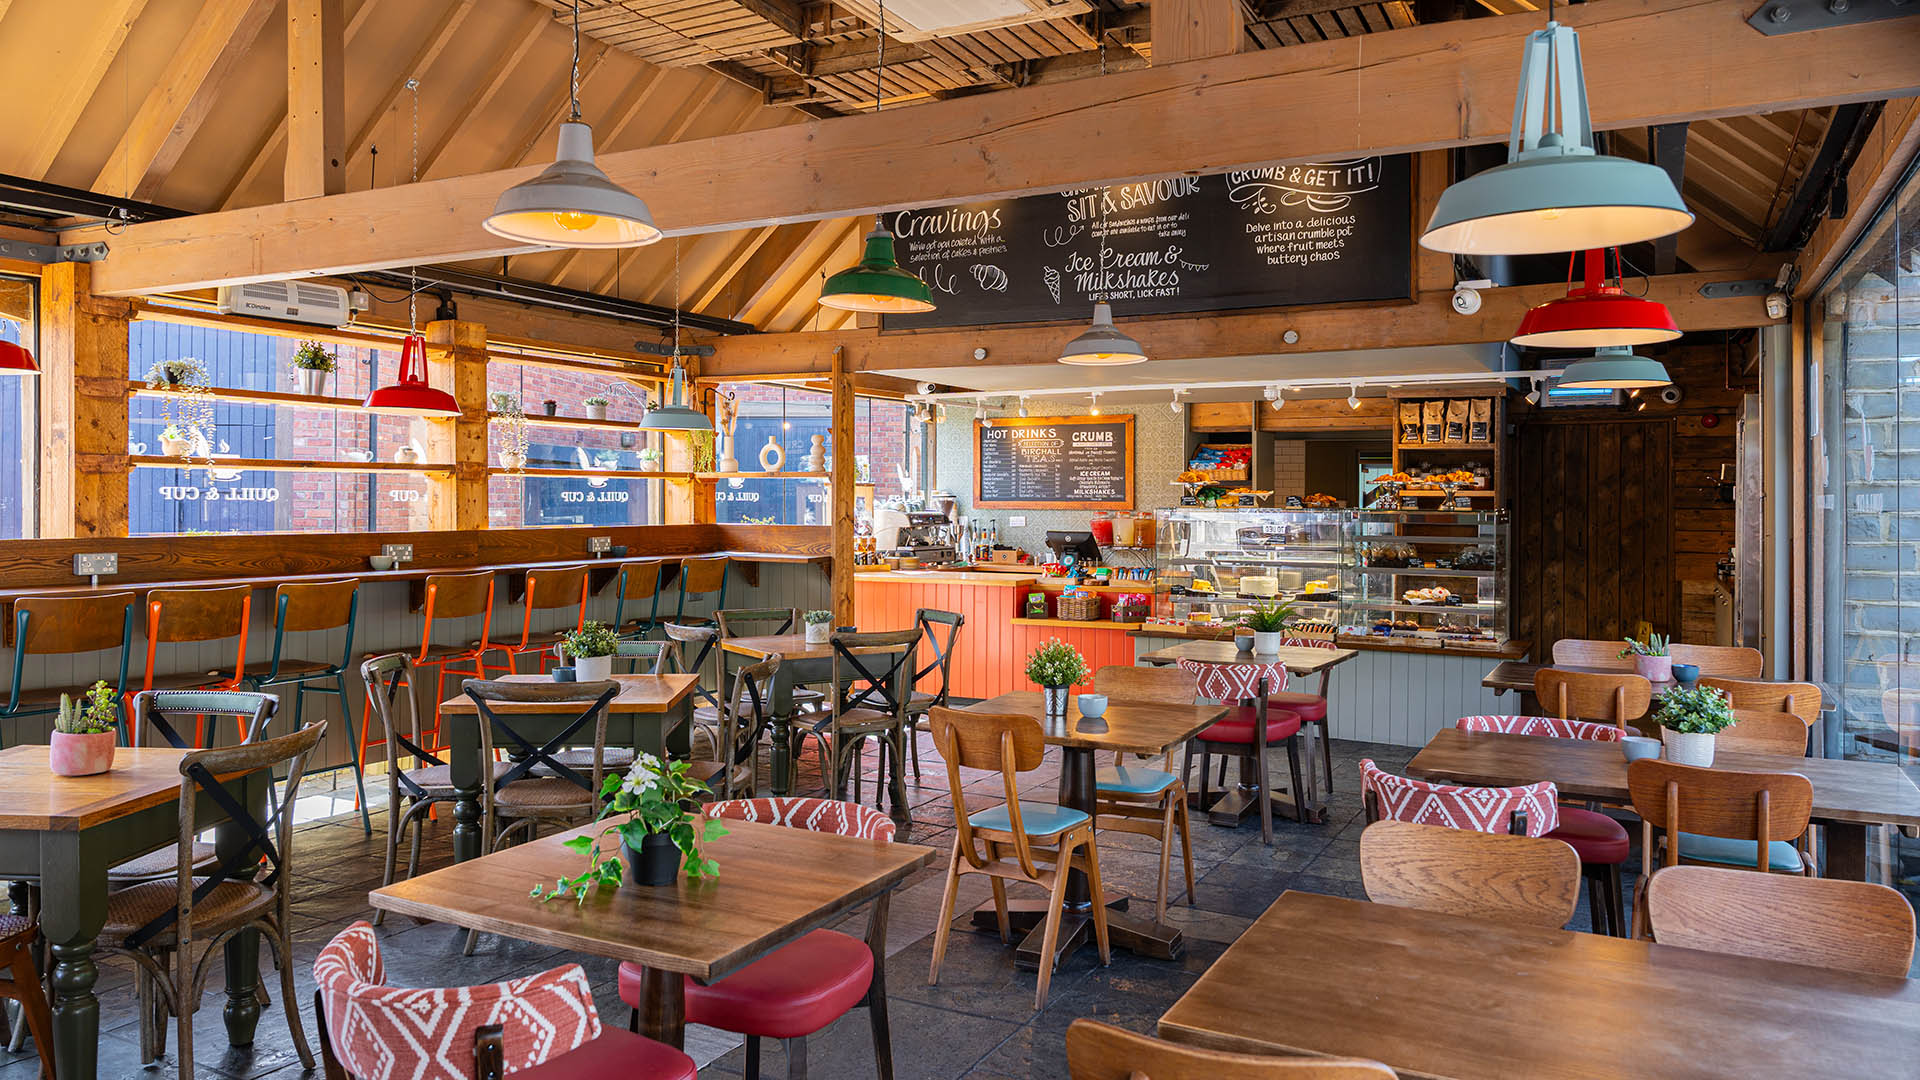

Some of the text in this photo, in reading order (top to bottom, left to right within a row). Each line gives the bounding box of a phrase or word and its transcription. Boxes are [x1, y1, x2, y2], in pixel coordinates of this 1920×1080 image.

[1231, 163, 1374, 187] CRUMB & GET IT!
[1067, 195, 1097, 222] SIT
[1101, 191, 1118, 215] &
[1120, 175, 1200, 211] SAVOUR
[895, 208, 1002, 239] Cravings
[1246, 215, 1356, 233] Delve into a delicious
[1254, 225, 1354, 243] artisan crumble pot
[1256, 238, 1345, 255] where fruit meets
[1065, 244, 1184, 273] Ice Cream &
[1267, 250, 1341, 267] buttery chaos
[1074, 267, 1180, 292] Milkshakes
[1137, 288, 1154, 298] LICK
[987, 427, 1057, 439] HOT DRINKS
[1072, 431, 1113, 442] CRUMB
[1021, 448, 1062, 456] BIRCHALL
